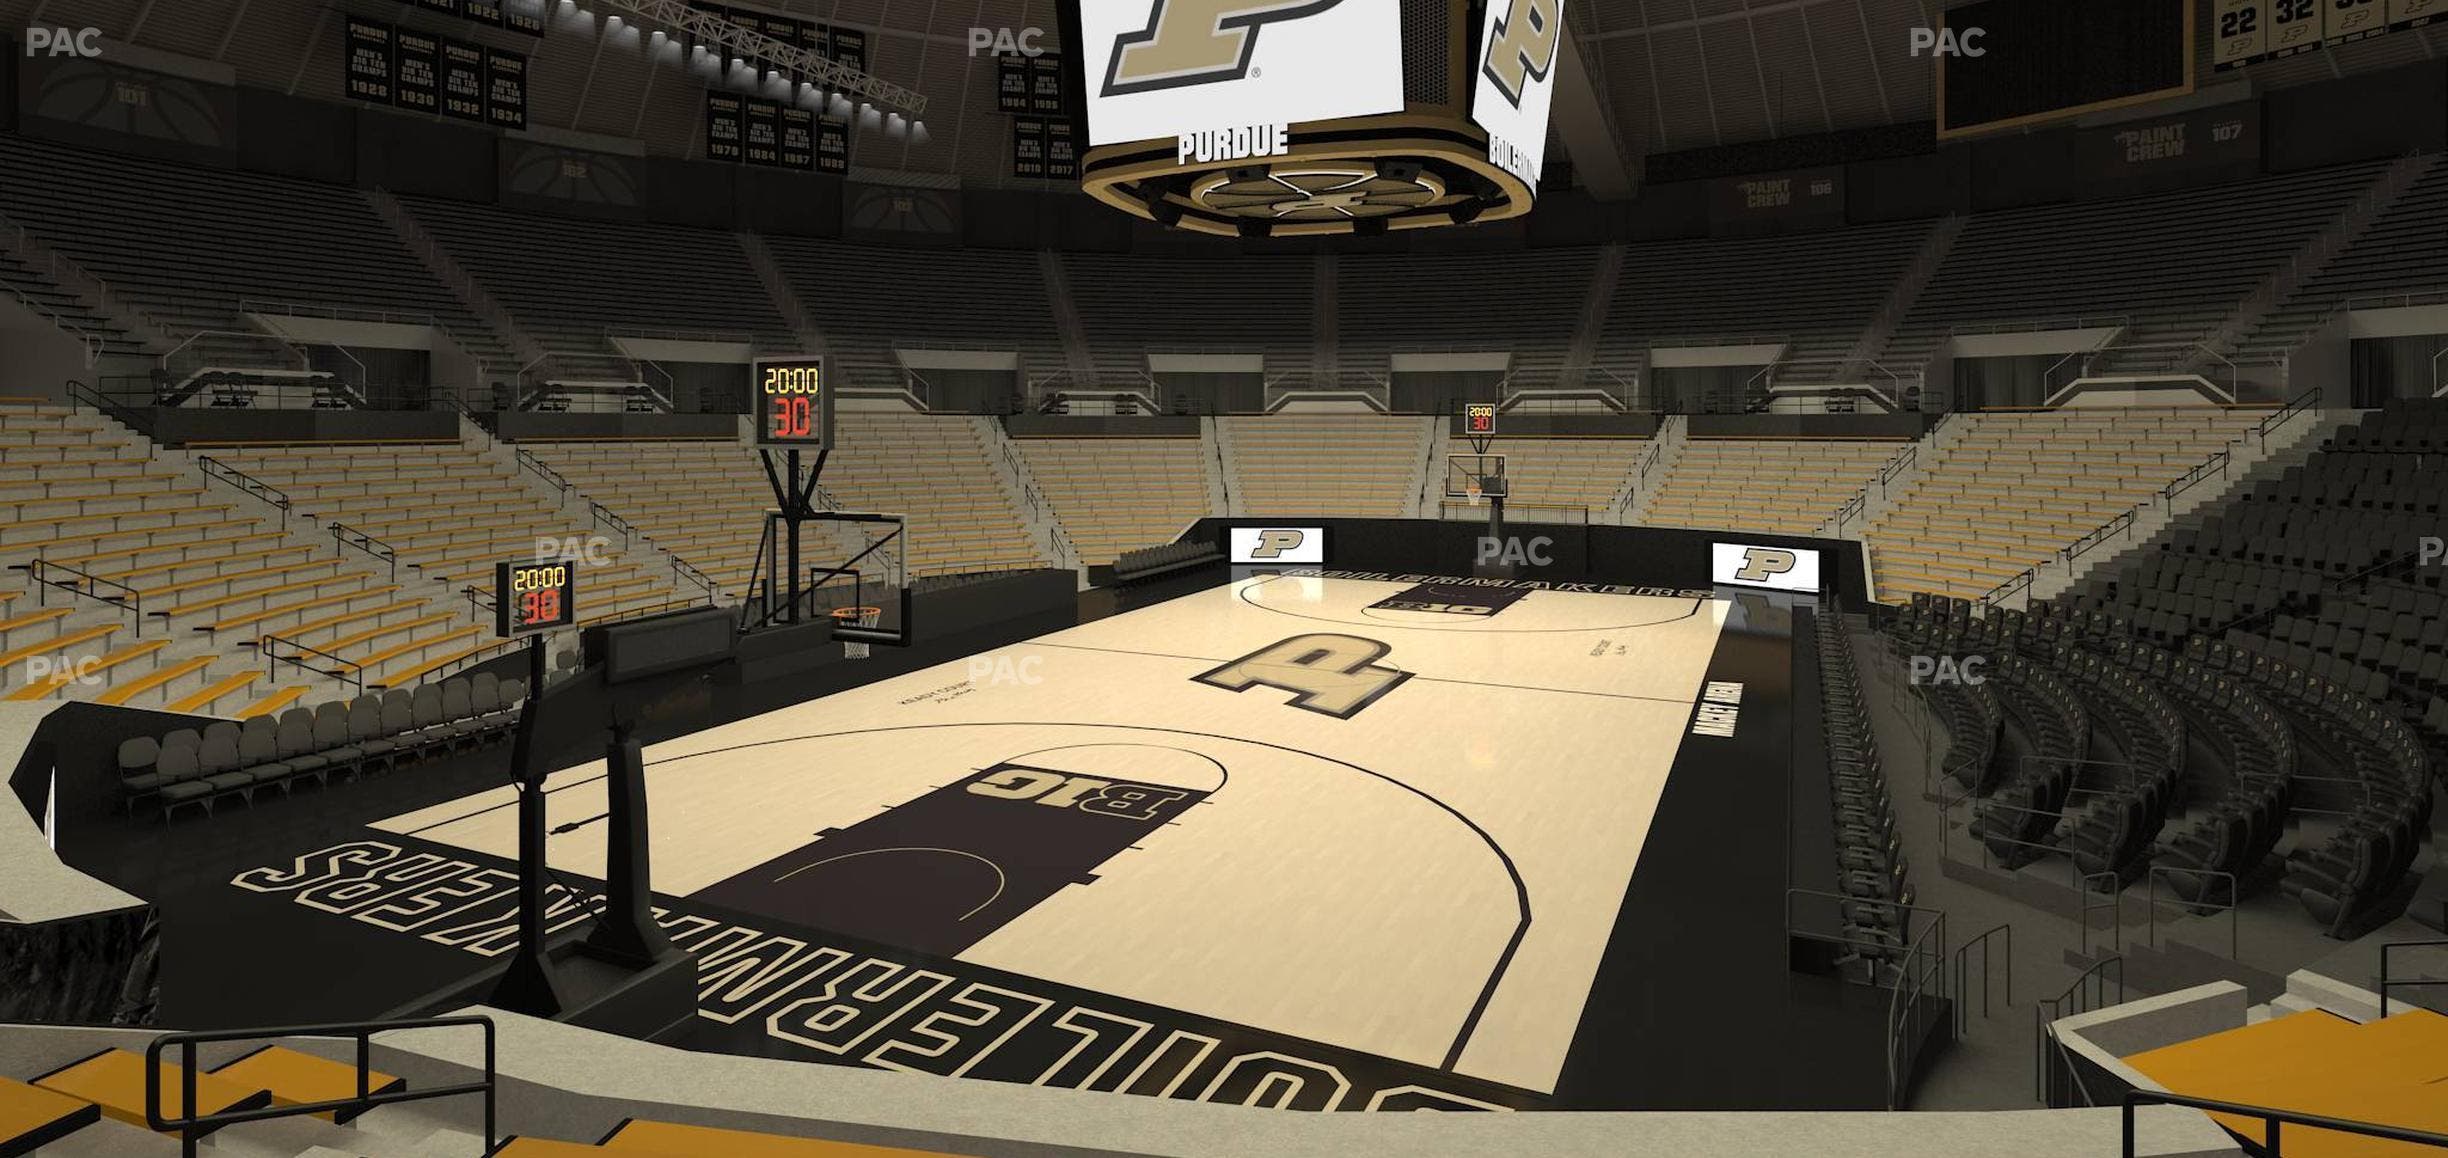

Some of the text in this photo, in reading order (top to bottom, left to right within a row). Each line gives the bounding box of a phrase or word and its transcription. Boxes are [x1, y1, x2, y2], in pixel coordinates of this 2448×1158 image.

[2221, 7, 2256, 38] 22
[2276, 0, 2313, 24] 32
[351, 79, 387, 97] 1928
[401, 89, 434, 106] 1930
[448, 99, 480, 115] 1932
[492, 107, 522, 124] 1934
[1178, 122, 1288, 165] PURDUE
[2124, 122, 2186, 146] PAINT
[2212, 124, 2242, 142] 107
[2126, 141, 2185, 162] CREW
[765, 368, 819, 394] 20:00
[773, 396, 811, 436] 30
[1469, 407, 1492, 417] 20:00
[1473, 417, 1489, 430] 30
[514, 566, 566, 591] 20:00
